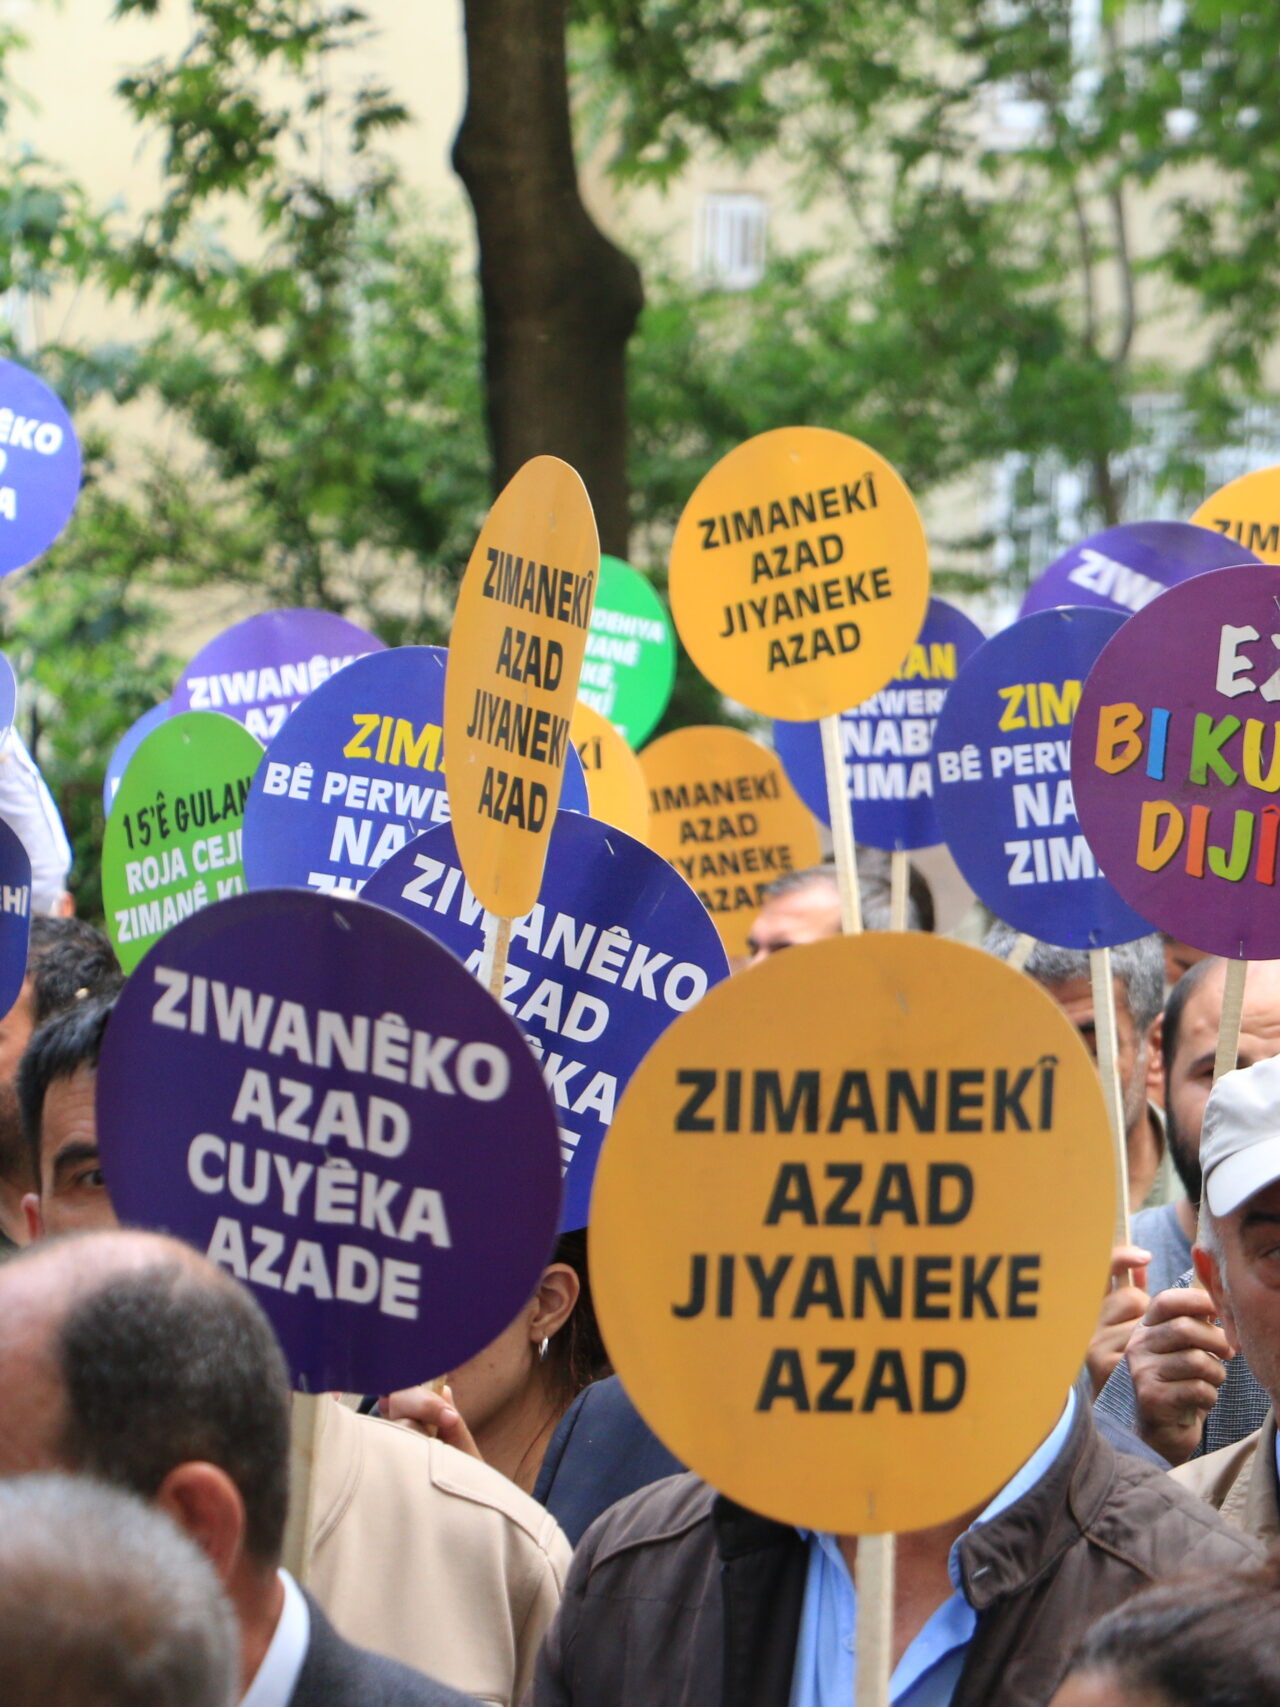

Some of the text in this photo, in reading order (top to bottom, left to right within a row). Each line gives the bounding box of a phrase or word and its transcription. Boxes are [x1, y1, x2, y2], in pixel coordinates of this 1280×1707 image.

[698, 472, 879, 551] ZIMANEKÎ
[482, 547, 594, 630] ZIMANEKÎ
[752, 533, 844, 585] AZAD
[719, 566, 892, 638] JIYANEKE
[495, 626, 564, 692] AZAD
[767, 621, 861, 673] AZAD
[187, 653, 373, 709] ZIWANÊ
[998, 680, 1082, 732] ZIM
[343, 713, 447, 774] ZIM
[466, 688, 570, 769] JIYANEK
[841, 718, 937, 758] NAB
[1094, 702, 1171, 782] BI
[263, 761, 452, 824] BÊ PERWE
[650, 769, 781, 815] IMANEKÎ
[937, 744, 982, 783] BÊ
[478, 766, 548, 834] AZAD
[679, 812, 759, 846] AZAD
[1012, 779, 1079, 829] NA
[125, 847, 187, 896] ROJA
[192, 828, 242, 874] CEJ
[329, 815, 428, 868] NA
[1004, 835, 1106, 886] ZIM
[151, 966, 511, 1102] ZIWANÊKO
[231, 1068, 411, 1159] AZAD
[673, 1055, 1059, 1133] ZIMANEKÎ
[187, 1133, 453, 1249] CUYÊKA
[762, 1162, 975, 1227] AZAD
[205, 1216, 421, 1321] AZADE
[671, 1253, 1042, 1320] JIYANEKE
[754, 1348, 968, 1414] AZAD
